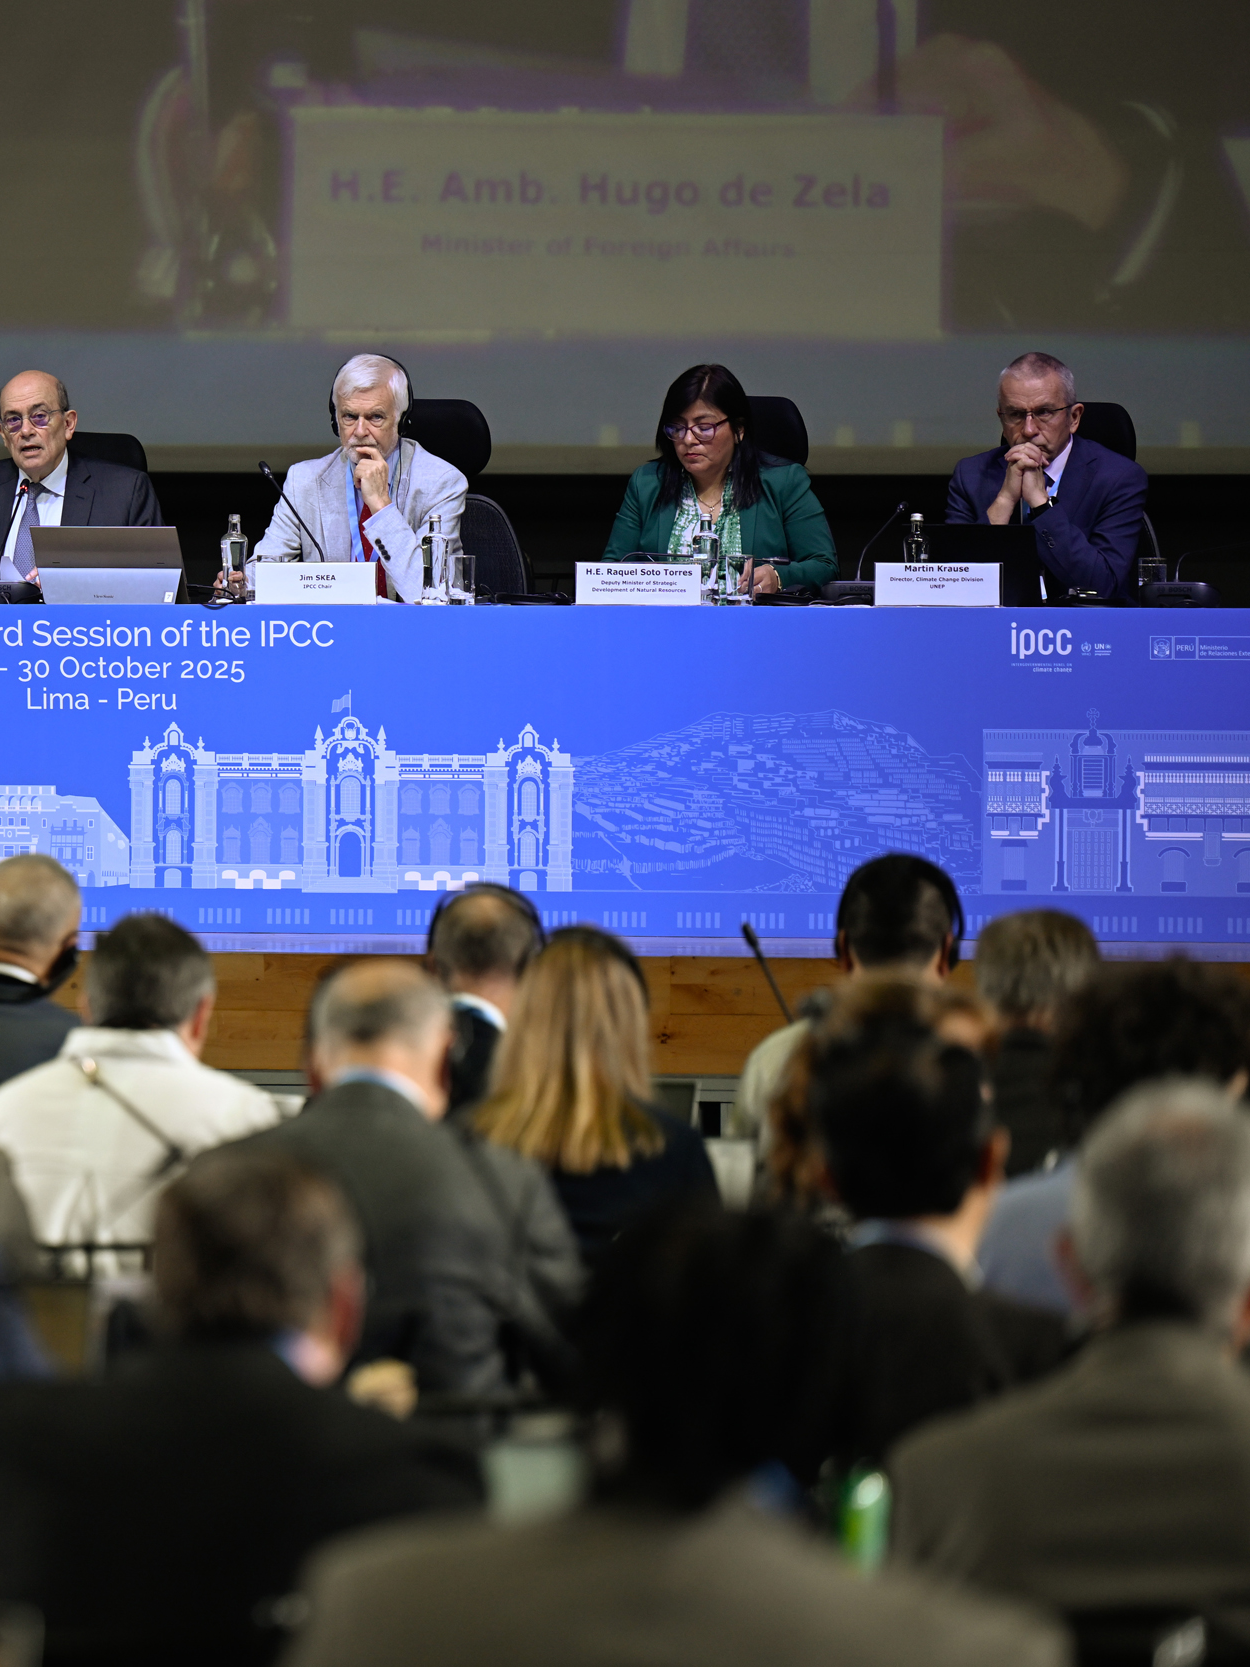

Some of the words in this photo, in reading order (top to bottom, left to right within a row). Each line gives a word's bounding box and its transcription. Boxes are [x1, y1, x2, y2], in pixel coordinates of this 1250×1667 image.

[330, 168, 421, 203] H.E.
[439, 169, 556, 205] Amb.
[580, 173, 699, 215] Hugo
[720, 173, 775, 207] de
[791, 173, 892, 209] Zela
[421, 233, 533, 256] Minister
[545, 235, 572, 256] of
[586, 567, 604, 576] H.E.
[607, 568, 638, 578] Raquel
[641, 568, 661, 576] Soto
[664, 568, 693, 576] Torres
[905, 565, 934, 573] Martin
[938, 565, 970, 573] Krause
[33, 619, 152, 648] Session
[160, 619, 194, 648] of
[198, 619, 251, 648] the
[260, 620, 335, 648] IPCC
[1011, 621, 1073, 659] ipcc
[1176, 642, 1196, 652] PERÚ
[17, 659, 50, 683] 30
[59, 655, 173, 679] October
[180, 659, 246, 684] 2025
[26, 686, 90, 710] Lima
[117, 687, 177, 711] Peru
